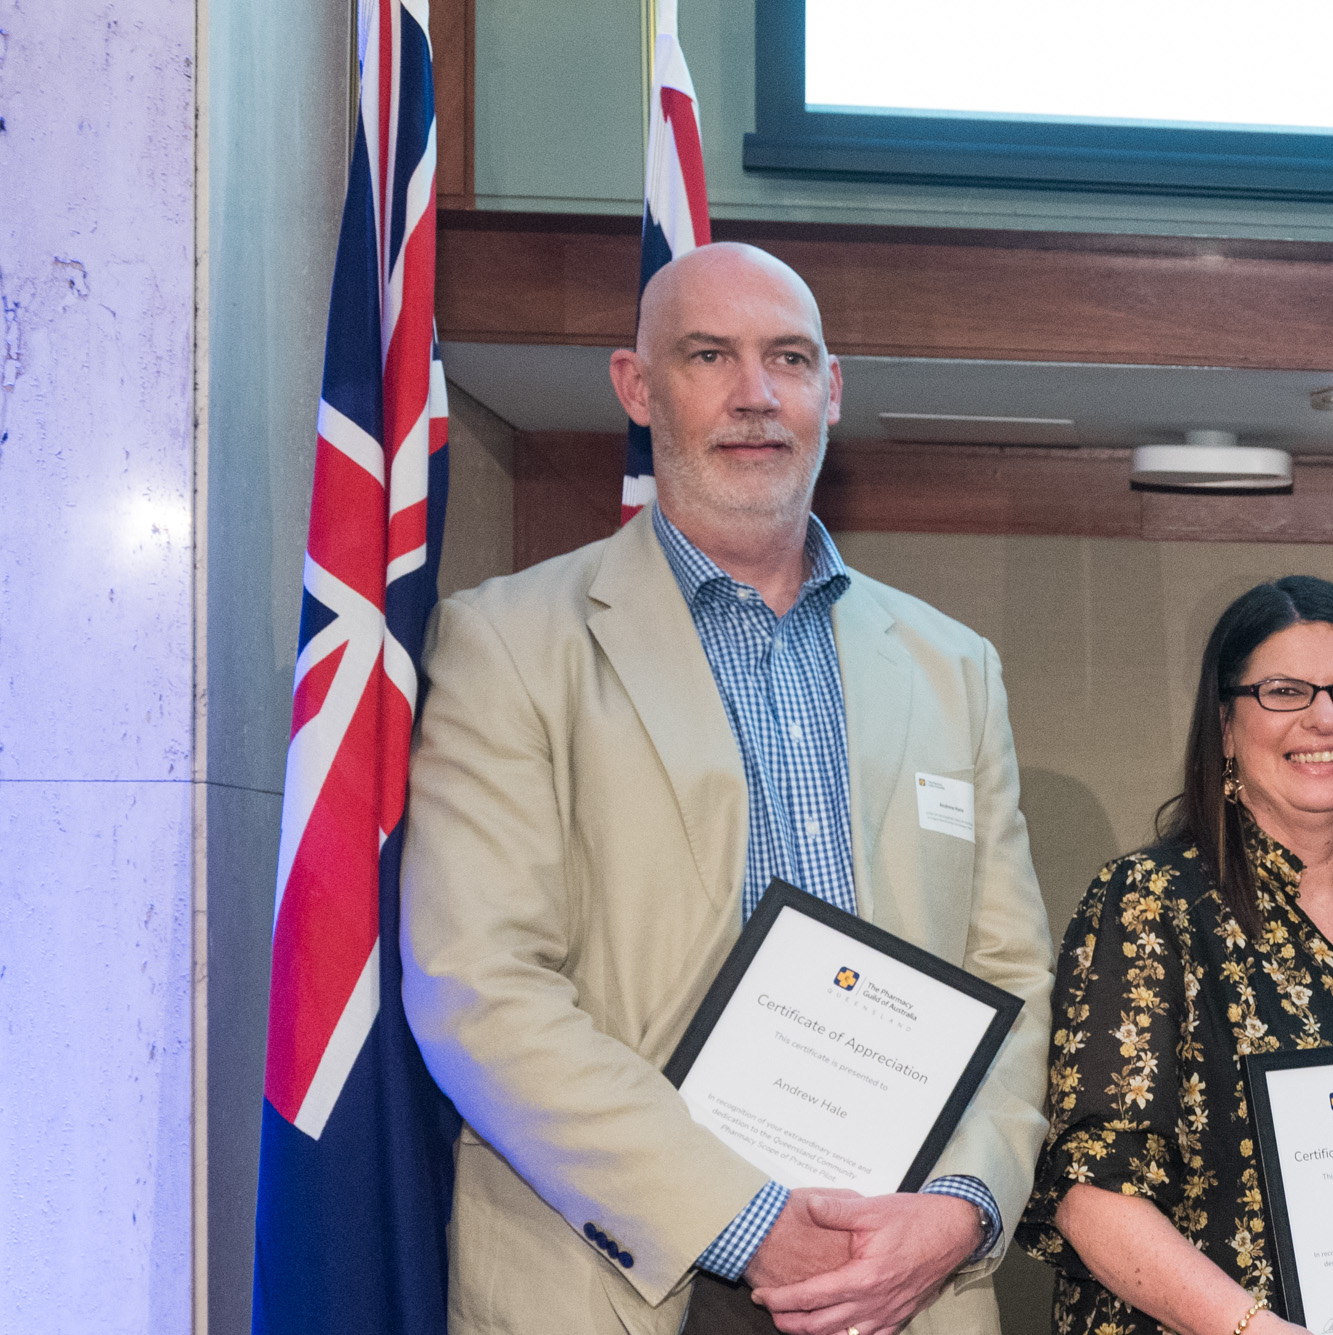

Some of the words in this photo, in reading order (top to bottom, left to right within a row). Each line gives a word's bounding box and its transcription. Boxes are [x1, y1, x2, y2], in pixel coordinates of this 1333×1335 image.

[827, 987, 912, 1032] QUEENSLAND
[862, 990, 882, 1003] Guild
[888, 1003, 917, 1021] Australia
[868, 982, 880, 993] The
[880, 988, 914, 1010] Pharmacy
[757, 994, 826, 1035] Certificate
[828, 1031, 845, 1042] of
[844, 1037, 928, 1085] Appreciation
[774, 1030, 791, 1044] This
[791, 1041, 830, 1064] certificate
[831, 1058, 839, 1067] is
[838, 1064, 880, 1087] presented
[879, 1082, 888, 1091] to
[773, 1078, 819, 1104] Andrew
[820, 1099, 847, 1118] Hale
